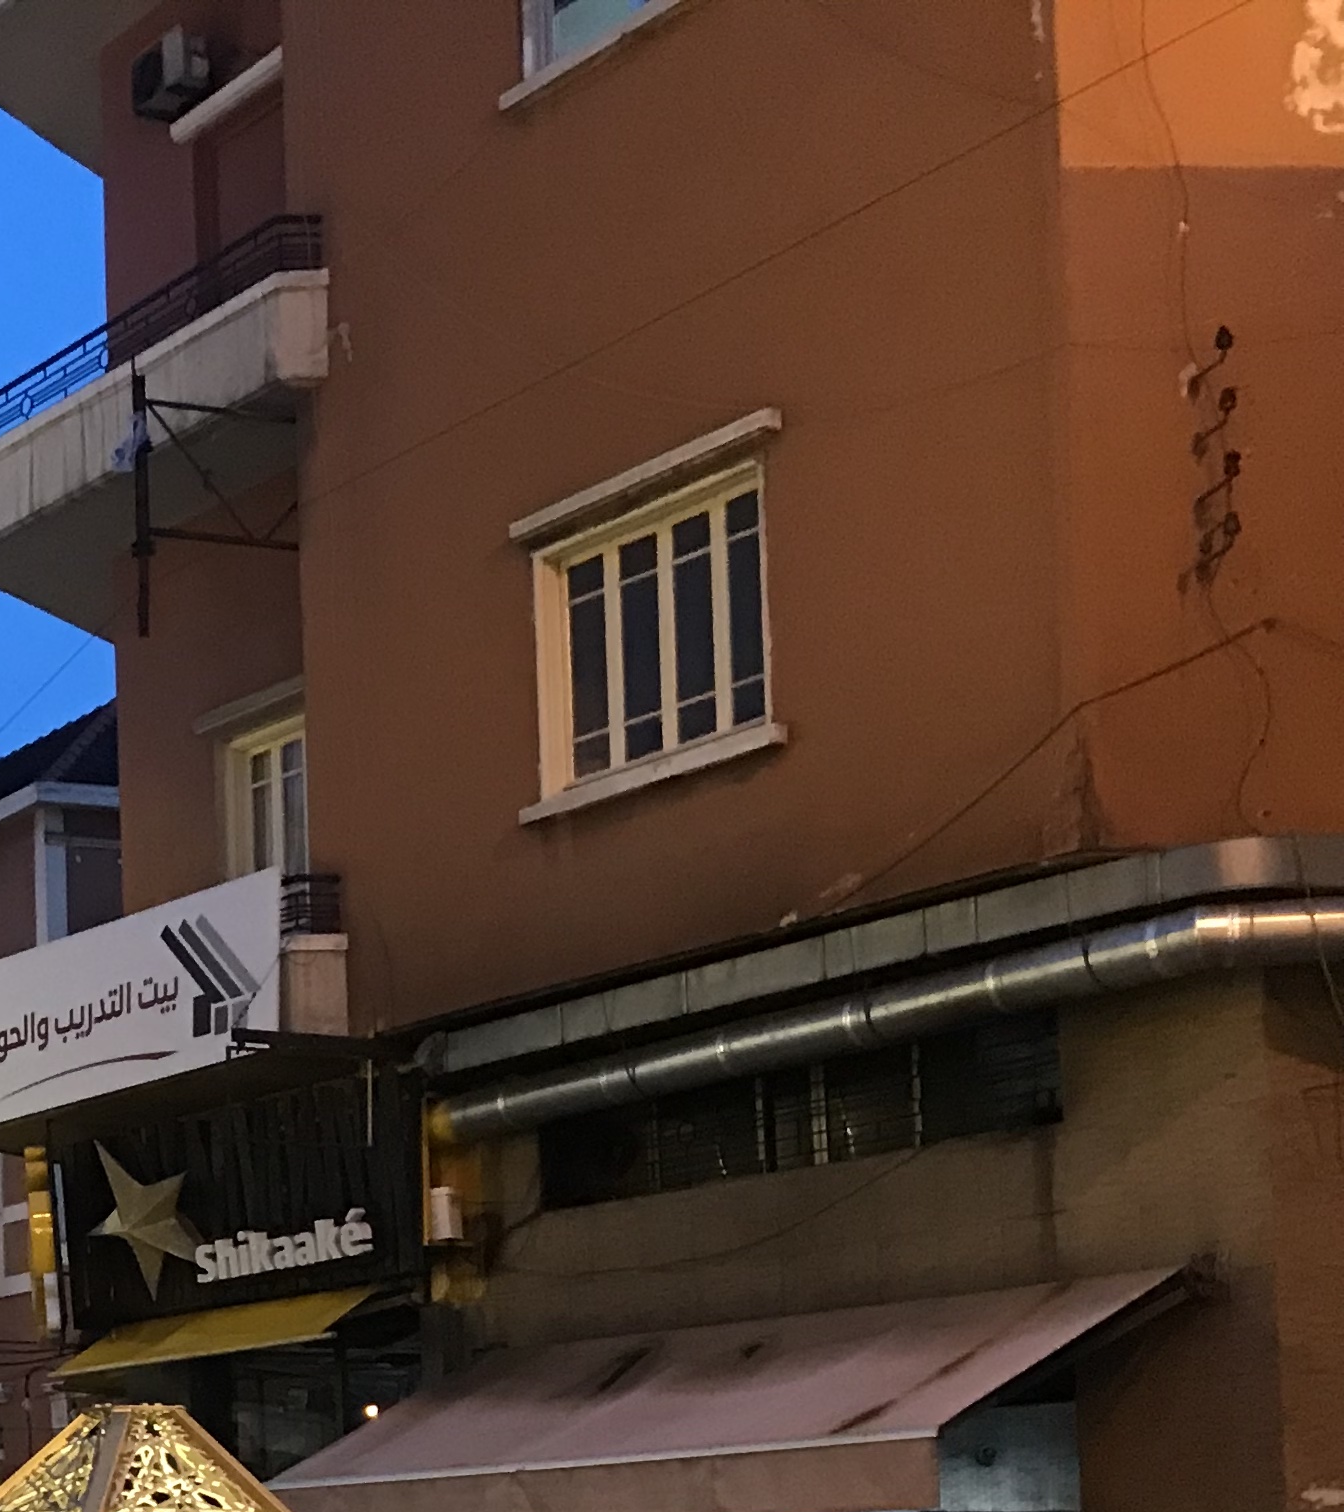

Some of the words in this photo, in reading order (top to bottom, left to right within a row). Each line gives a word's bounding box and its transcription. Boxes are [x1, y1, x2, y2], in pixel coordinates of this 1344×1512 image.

[54, 980, 132, 1044] التدريب
[137, 975, 180, 1015] بيت
[194, 1206, 375, 1284] Shikaaké
